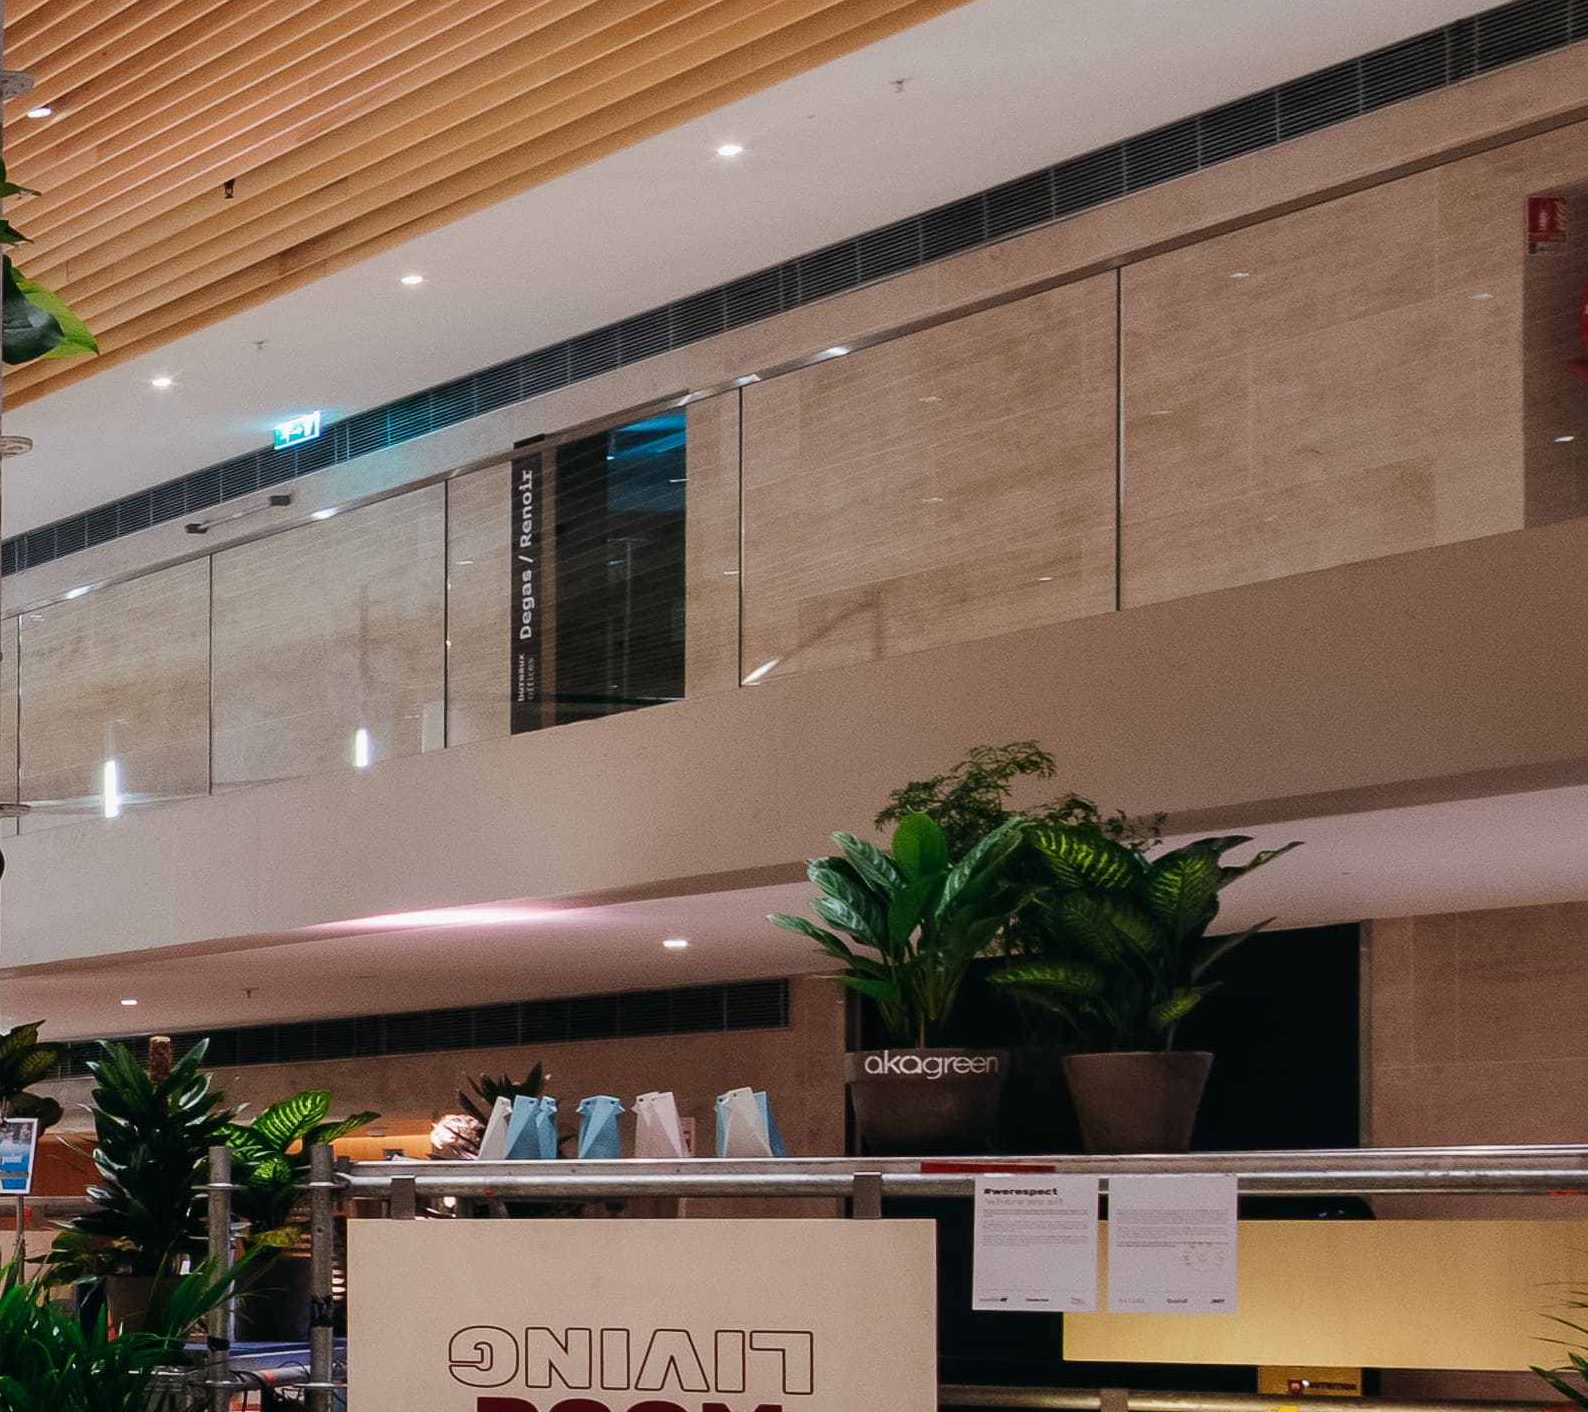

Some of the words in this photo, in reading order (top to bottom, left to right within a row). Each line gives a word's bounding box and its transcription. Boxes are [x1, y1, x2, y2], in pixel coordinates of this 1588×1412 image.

[520, 470, 532, 548] Renoir
[520, 569, 535, 639] Degas
[864, 1050, 999, 1079] akagreen
[984, 1188, 1058, 1197] #werespect
[448, 1326, 814, 1395] LIVING
